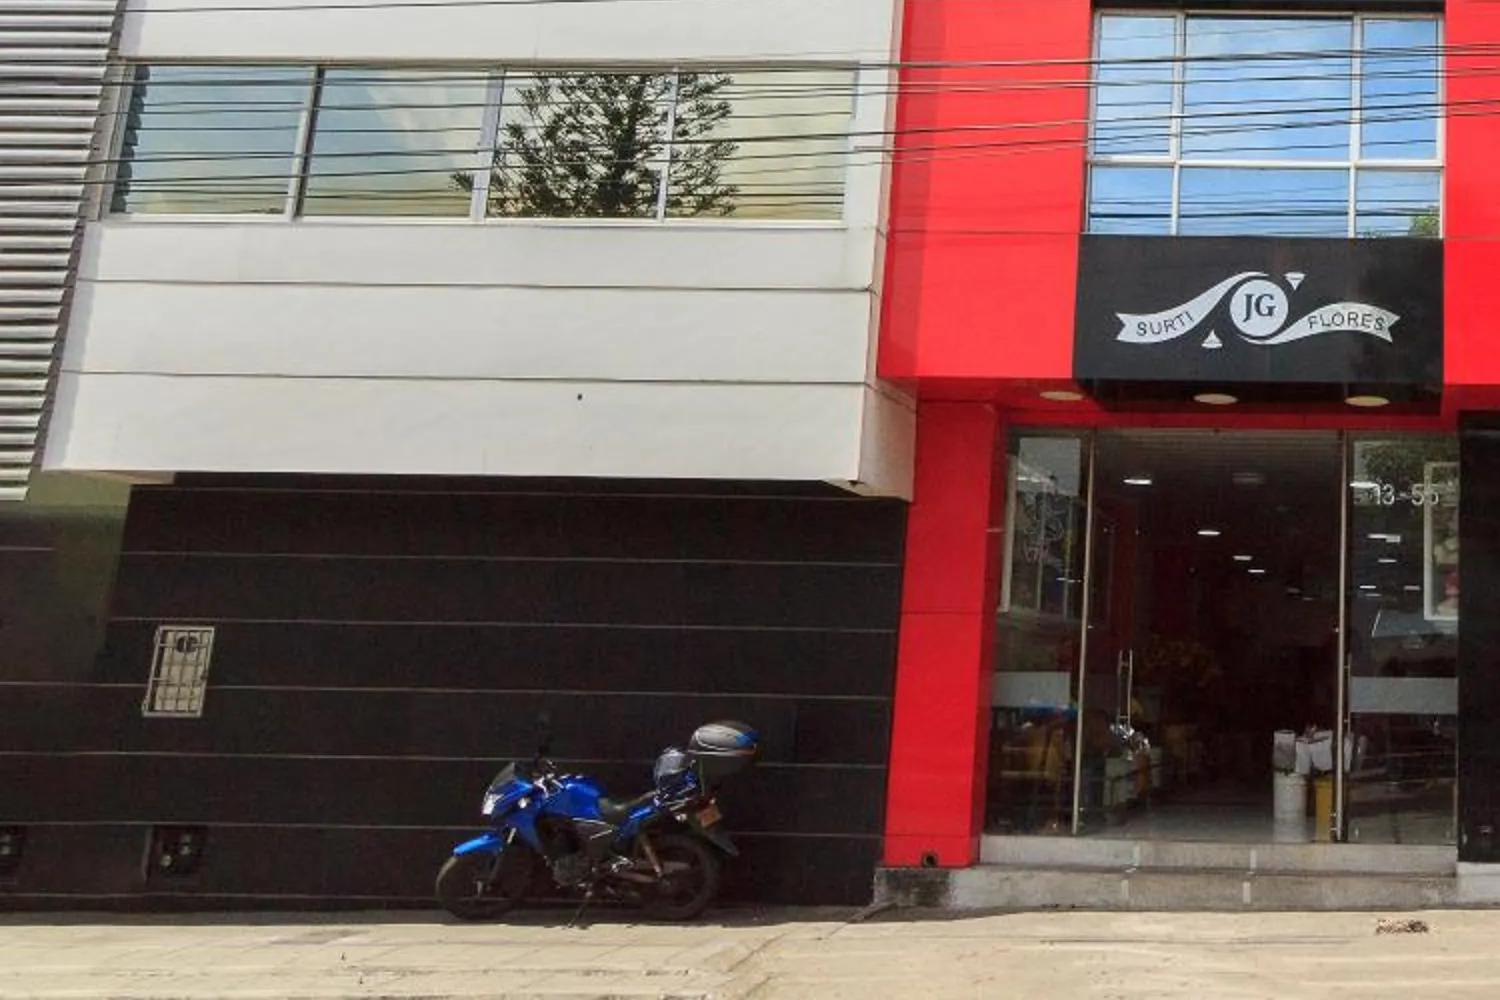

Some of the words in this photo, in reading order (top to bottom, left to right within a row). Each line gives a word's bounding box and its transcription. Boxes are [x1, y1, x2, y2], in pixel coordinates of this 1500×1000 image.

[1243, 294, 1277, 322] JG
[1136, 311, 1194, 337] SURTI
[1307, 311, 1385, 332] FLORES
